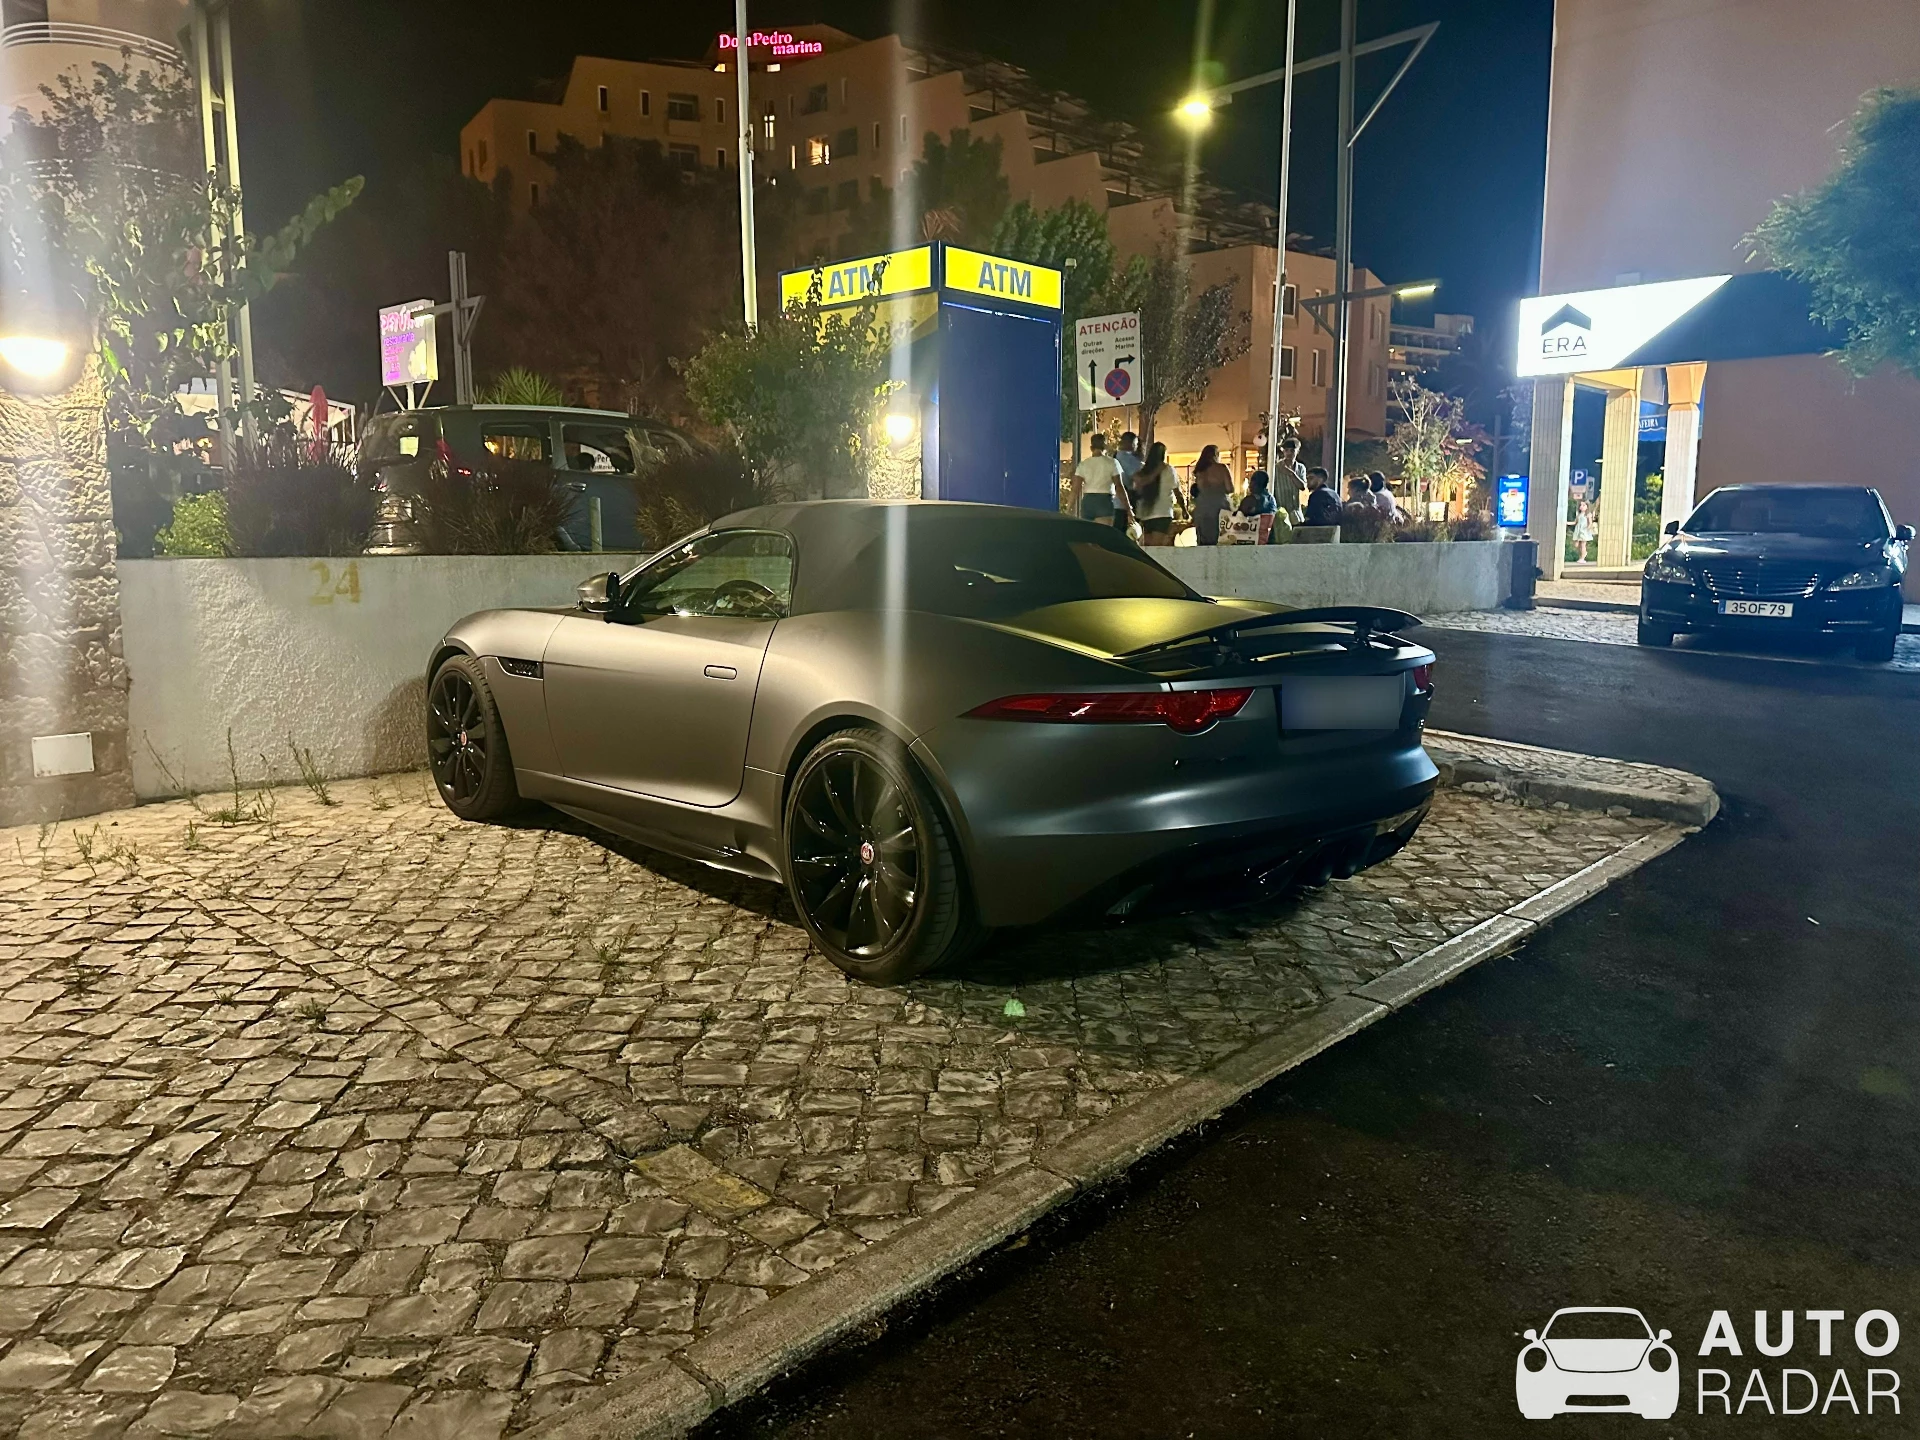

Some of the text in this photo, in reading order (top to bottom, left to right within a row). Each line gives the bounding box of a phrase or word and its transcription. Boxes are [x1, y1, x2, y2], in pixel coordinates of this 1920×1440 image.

[753, 31, 793, 46] Pedro
[772, 41, 822, 55] marina
[978, 261, 1031, 298] ATM
[1080, 317, 1137, 336] ATENÇÃO
[1081, 347, 1105, 355] direções
[1083, 340, 1103, 348] Outras
[1542, 335, 1587, 354] ERA
[1574, 471, 1584, 484] P
[308, 561, 361, 606] 24
